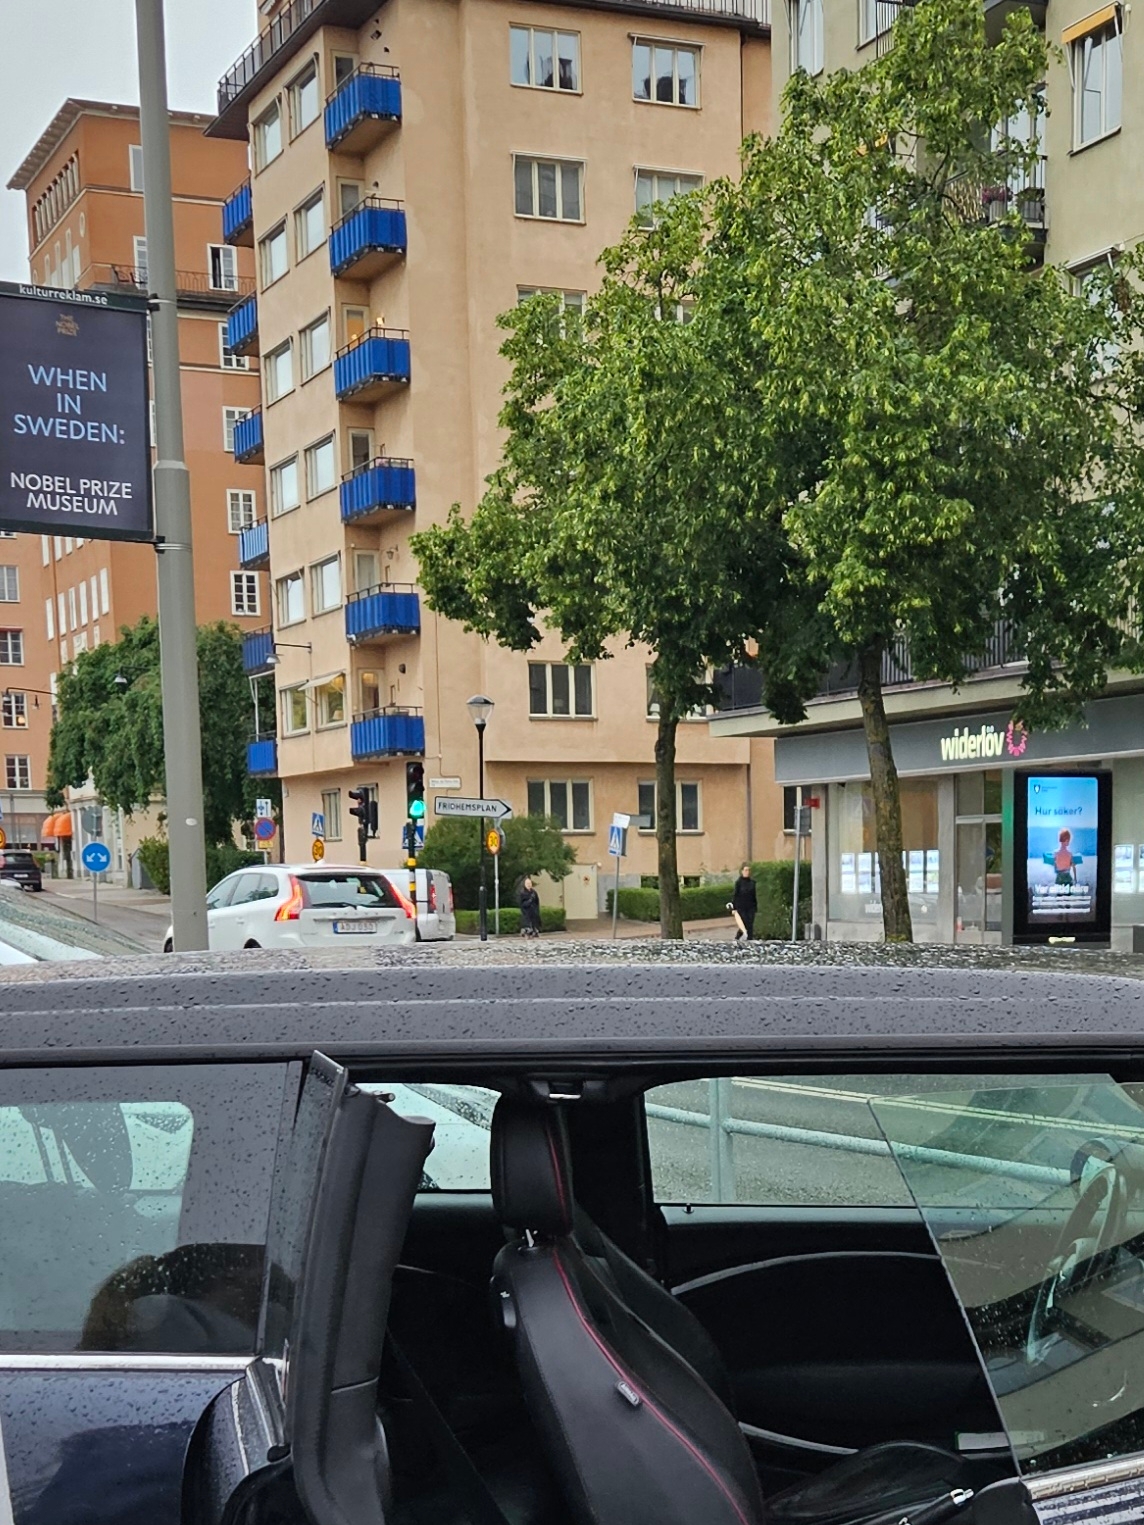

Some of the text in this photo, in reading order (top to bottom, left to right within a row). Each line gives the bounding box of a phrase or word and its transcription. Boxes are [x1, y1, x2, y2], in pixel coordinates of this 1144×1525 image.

[19, 283, 108, 305] kulturreklam.se
[28, 364, 107, 392] WHEN
[57, 393, 81, 415] IN
[14, 414, 125, 444] SWEDEN:
[10, 472, 132, 499] NOBEL PRIZE
[27, 492, 118, 515] MUSEUM
[941, 724, 1005, 760] widerlöv
[438, 801, 497, 812] FRIDHEMSPLAN
